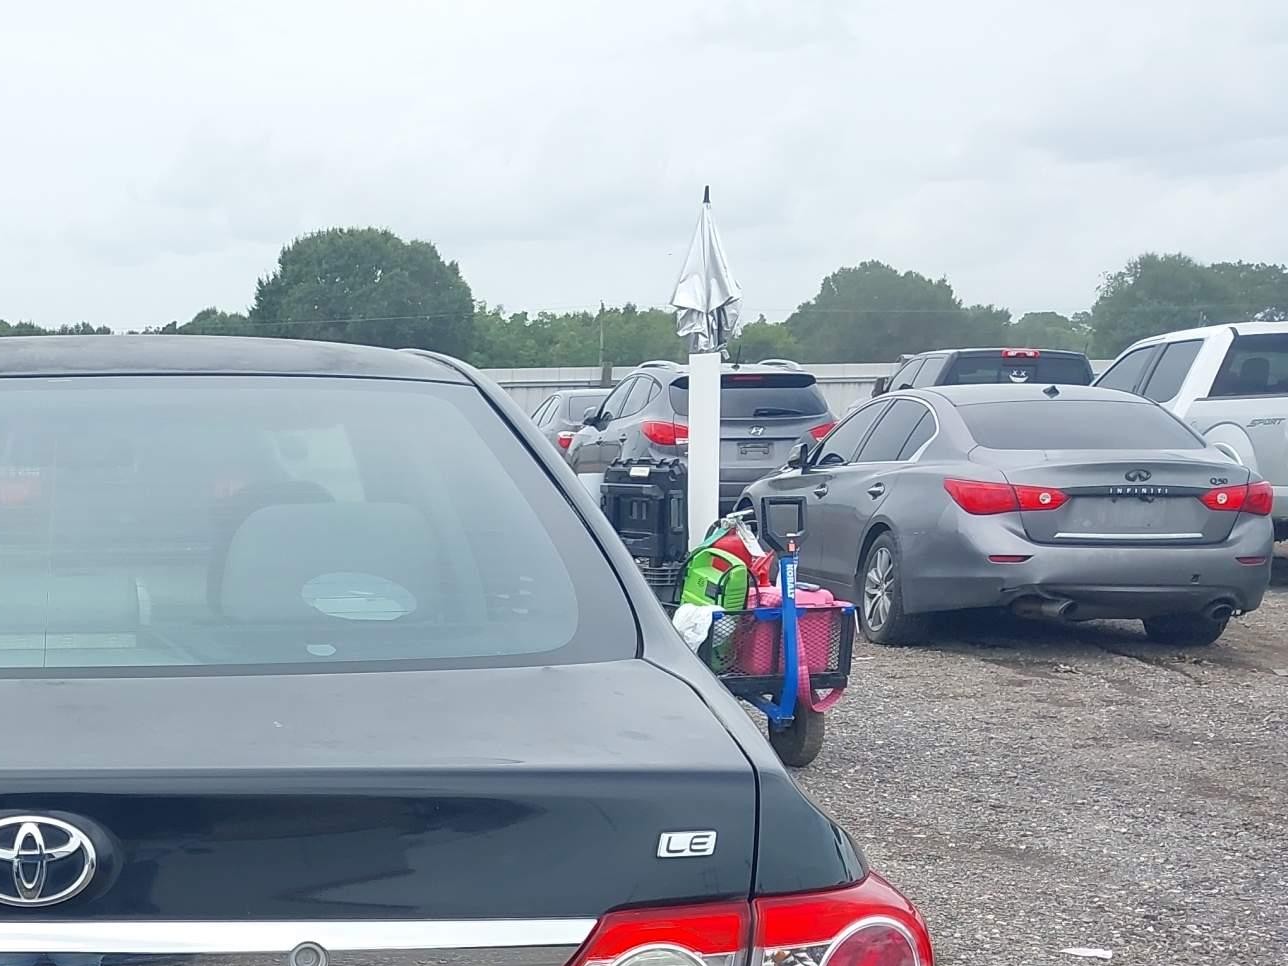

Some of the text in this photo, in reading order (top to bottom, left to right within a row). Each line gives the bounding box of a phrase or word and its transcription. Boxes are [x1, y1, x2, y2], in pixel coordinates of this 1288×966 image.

[1246, 418, 1286, 427] SPORT
[1209, 477, 1228, 485] Q50
[785, 564, 795, 599] KOBALT
[663, 833, 713, 855] LE
